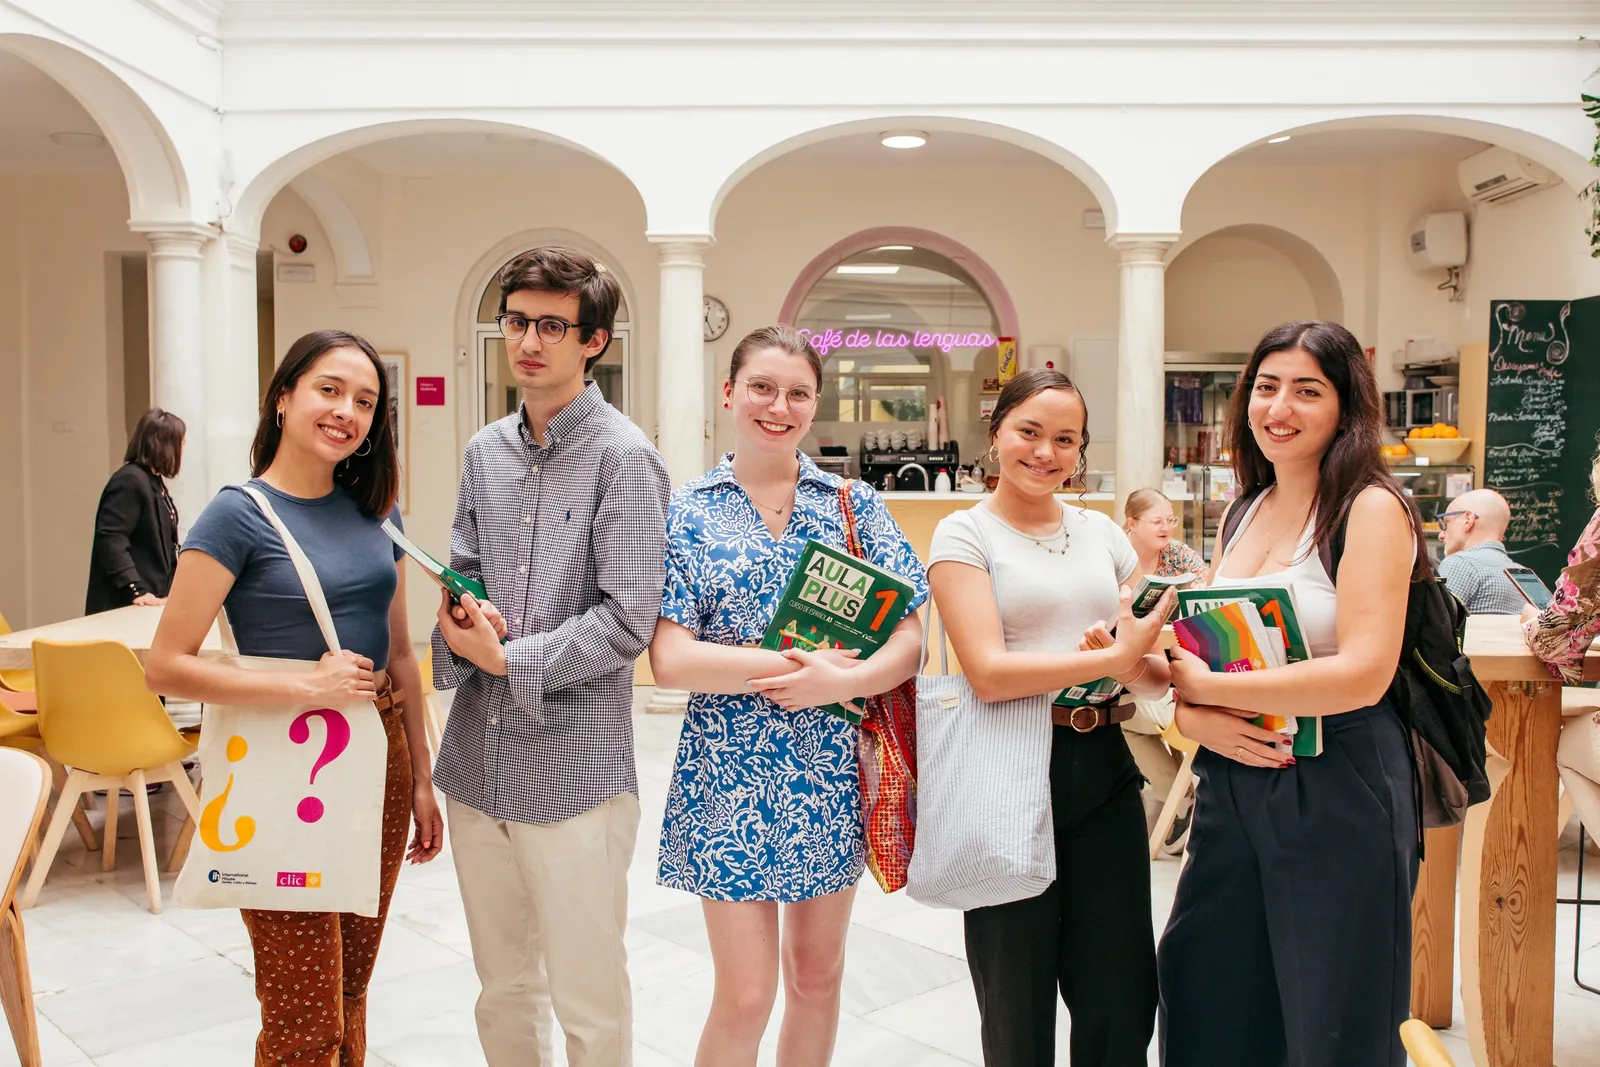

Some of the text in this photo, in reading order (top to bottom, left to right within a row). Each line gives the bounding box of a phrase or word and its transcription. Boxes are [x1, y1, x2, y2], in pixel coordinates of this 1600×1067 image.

[845, 329, 872, 349] de
[875, 330, 911, 348] las
[913, 330, 995, 353] lenguas
[808, 556, 868, 597] AULA
[788, 599, 834, 624] CURSO DE ESPAÑOL A1
[802, 580, 861, 619] PLUS
[869, 589, 900, 632] 1
[1261, 599, 1291, 649] 1
[280, 874, 304, 886] clic
